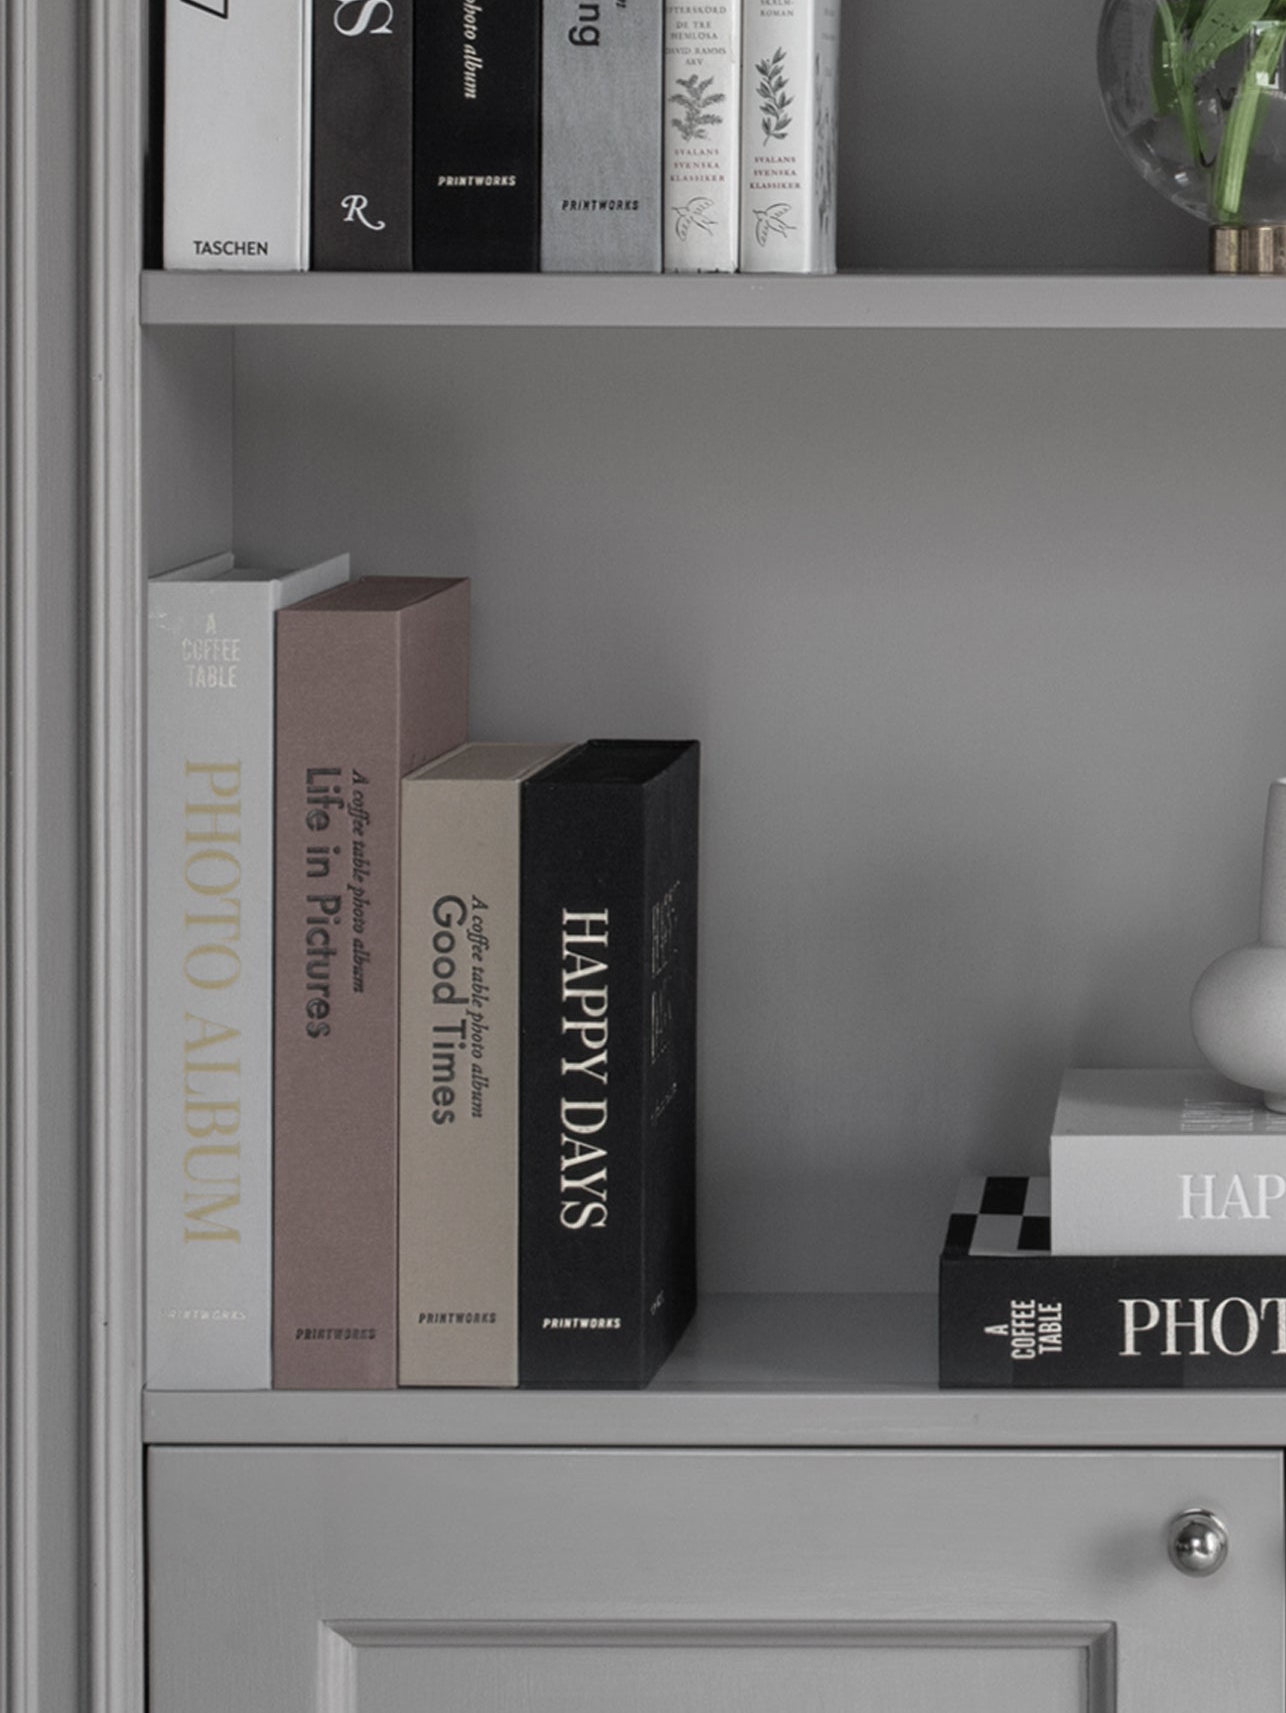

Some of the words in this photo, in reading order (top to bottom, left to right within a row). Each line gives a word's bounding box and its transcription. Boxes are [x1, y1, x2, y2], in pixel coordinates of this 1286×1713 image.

[464, 44, 483, 98] album
[194, 241, 268, 255] TASCHEN
[181, 638, 240, 662] COFFEE
[206, 613, 216, 634] A
[184, 664, 237, 688] TABLE
[306, 768, 342, 831] Life
[183, 759, 242, 991] PHOTO
[307, 846, 340, 878] in
[472, 895, 488, 910] A
[432, 895, 467, 1004] Good
[466, 915, 490, 962] coffee
[306, 895, 342, 1038] Pictures
[471, 966, 489, 1008] table
[562, 909, 608, 1084] HAPPY
[466, 1011, 489, 1059] photo
[432, 1019, 467, 1125] Times
[472, 1063, 489, 1118] album
[183, 1011, 242, 1245] ALBUM
[560, 1098, 607, 1229] DAYS
[984, 1322, 1010, 1336] A
[1011, 1299, 1035, 1361] COFFEE
[1038, 1302, 1063, 1354] TABLE
